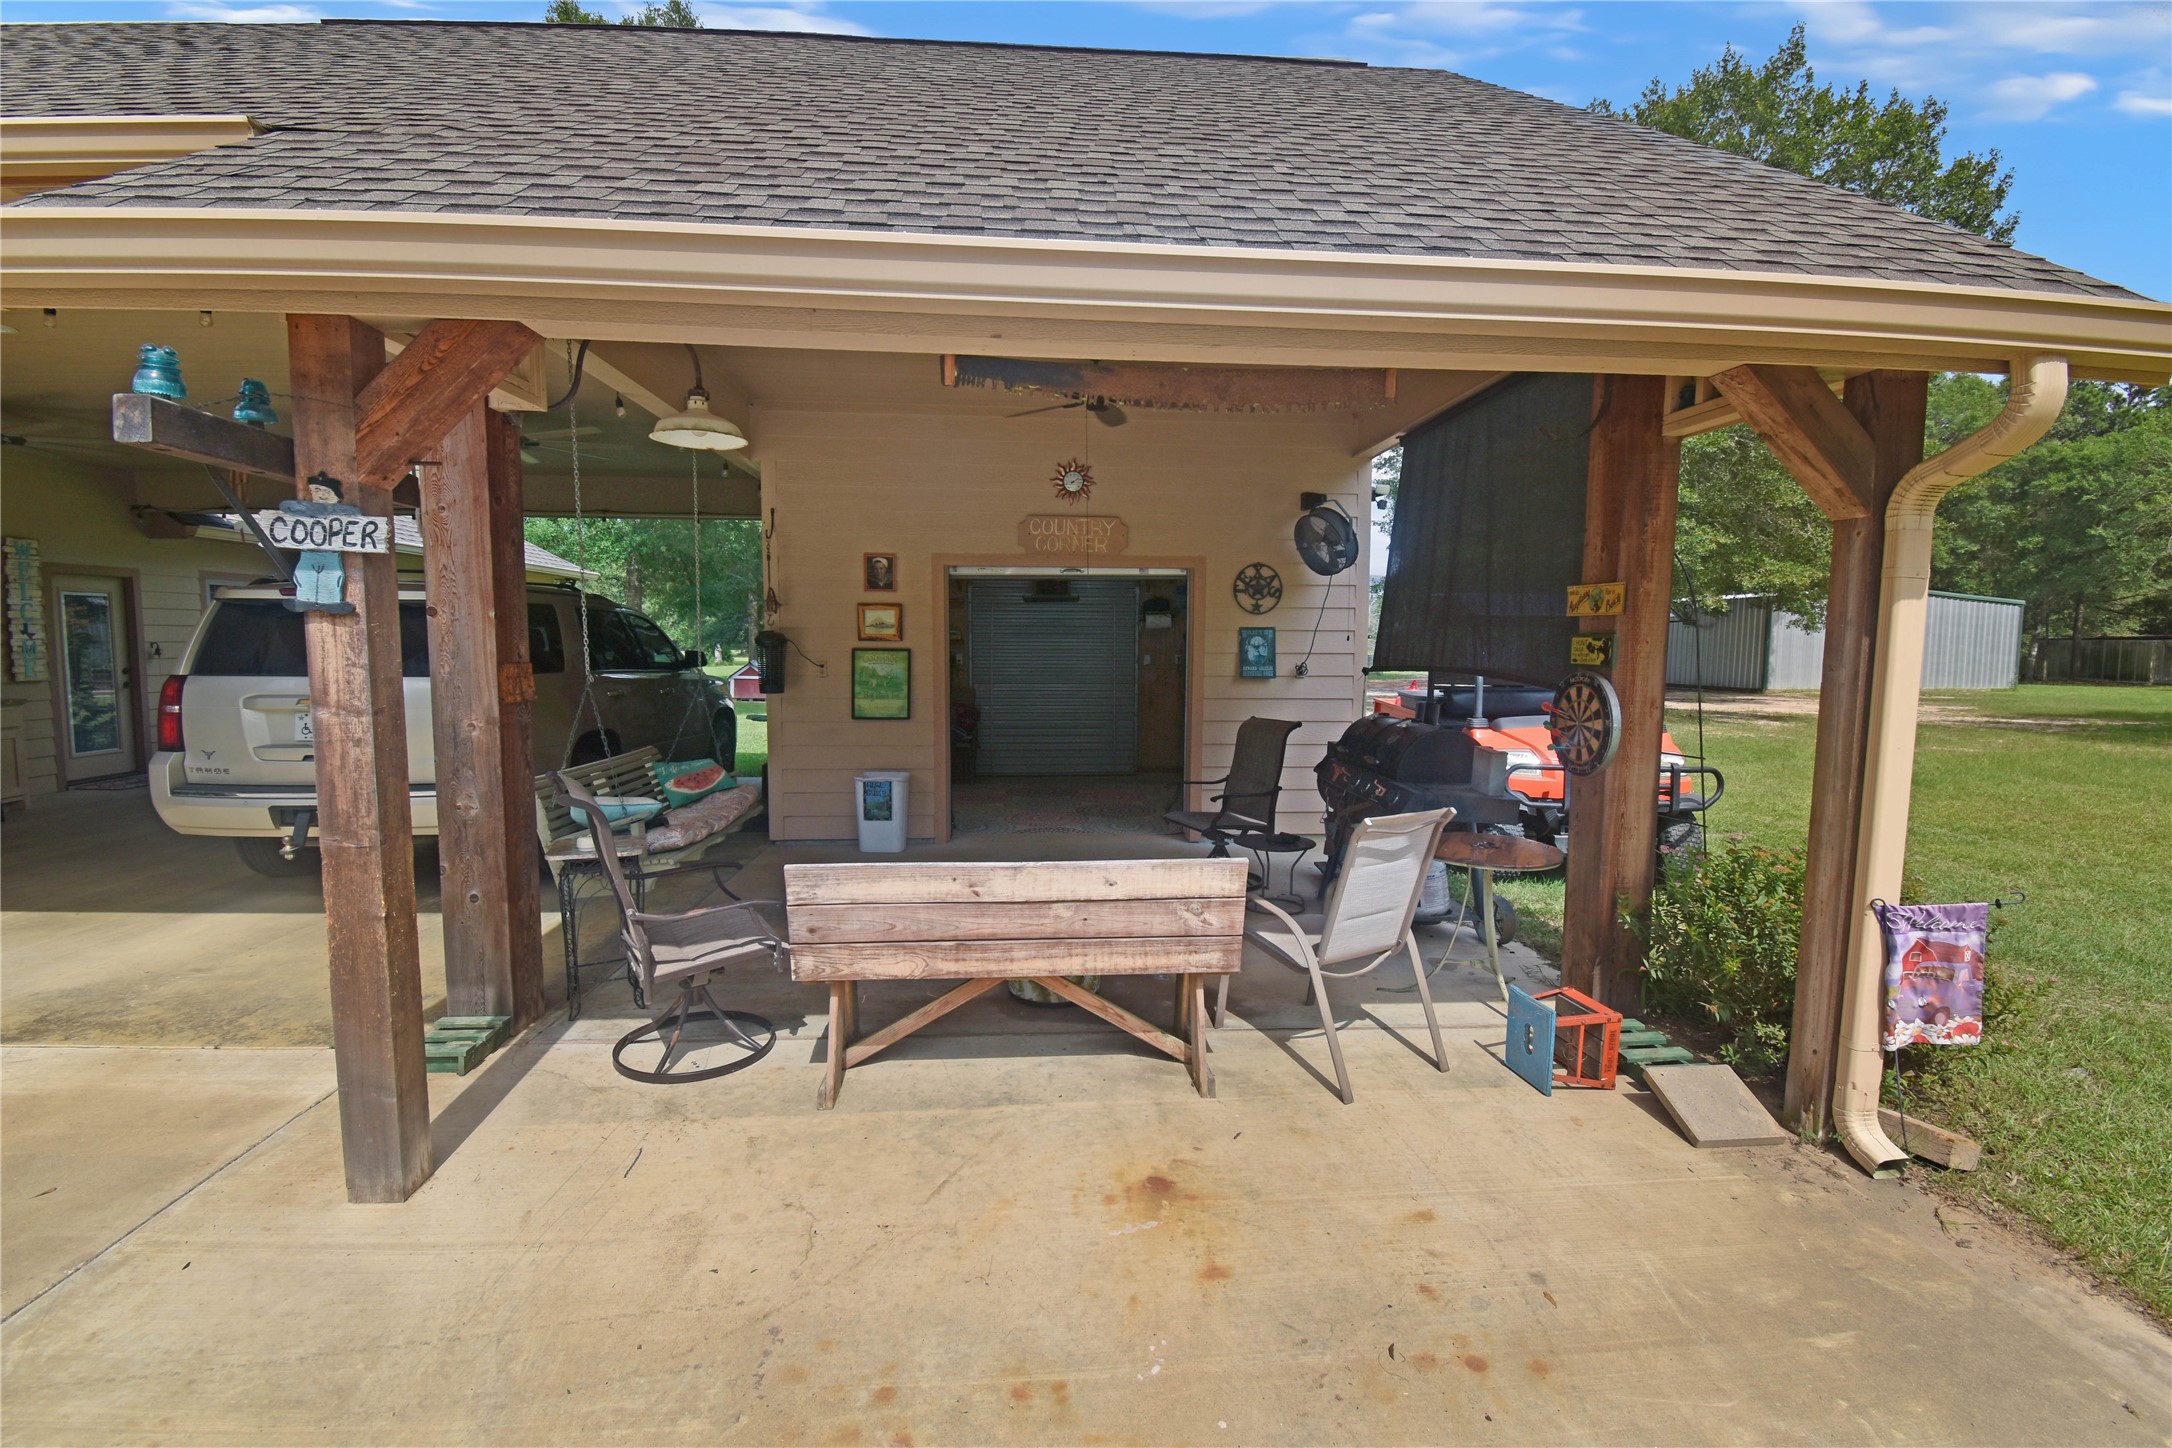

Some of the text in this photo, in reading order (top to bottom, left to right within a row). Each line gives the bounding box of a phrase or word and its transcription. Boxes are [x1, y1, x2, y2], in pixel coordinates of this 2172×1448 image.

[270, 516, 379, 549] COOPER
[1029, 518, 1117, 536] COUNTRY
[1035, 535, 1108, 553] CORNER
[189, 767, 230, 775] TAHOE
[1886, 909, 1983, 935] Welcome
